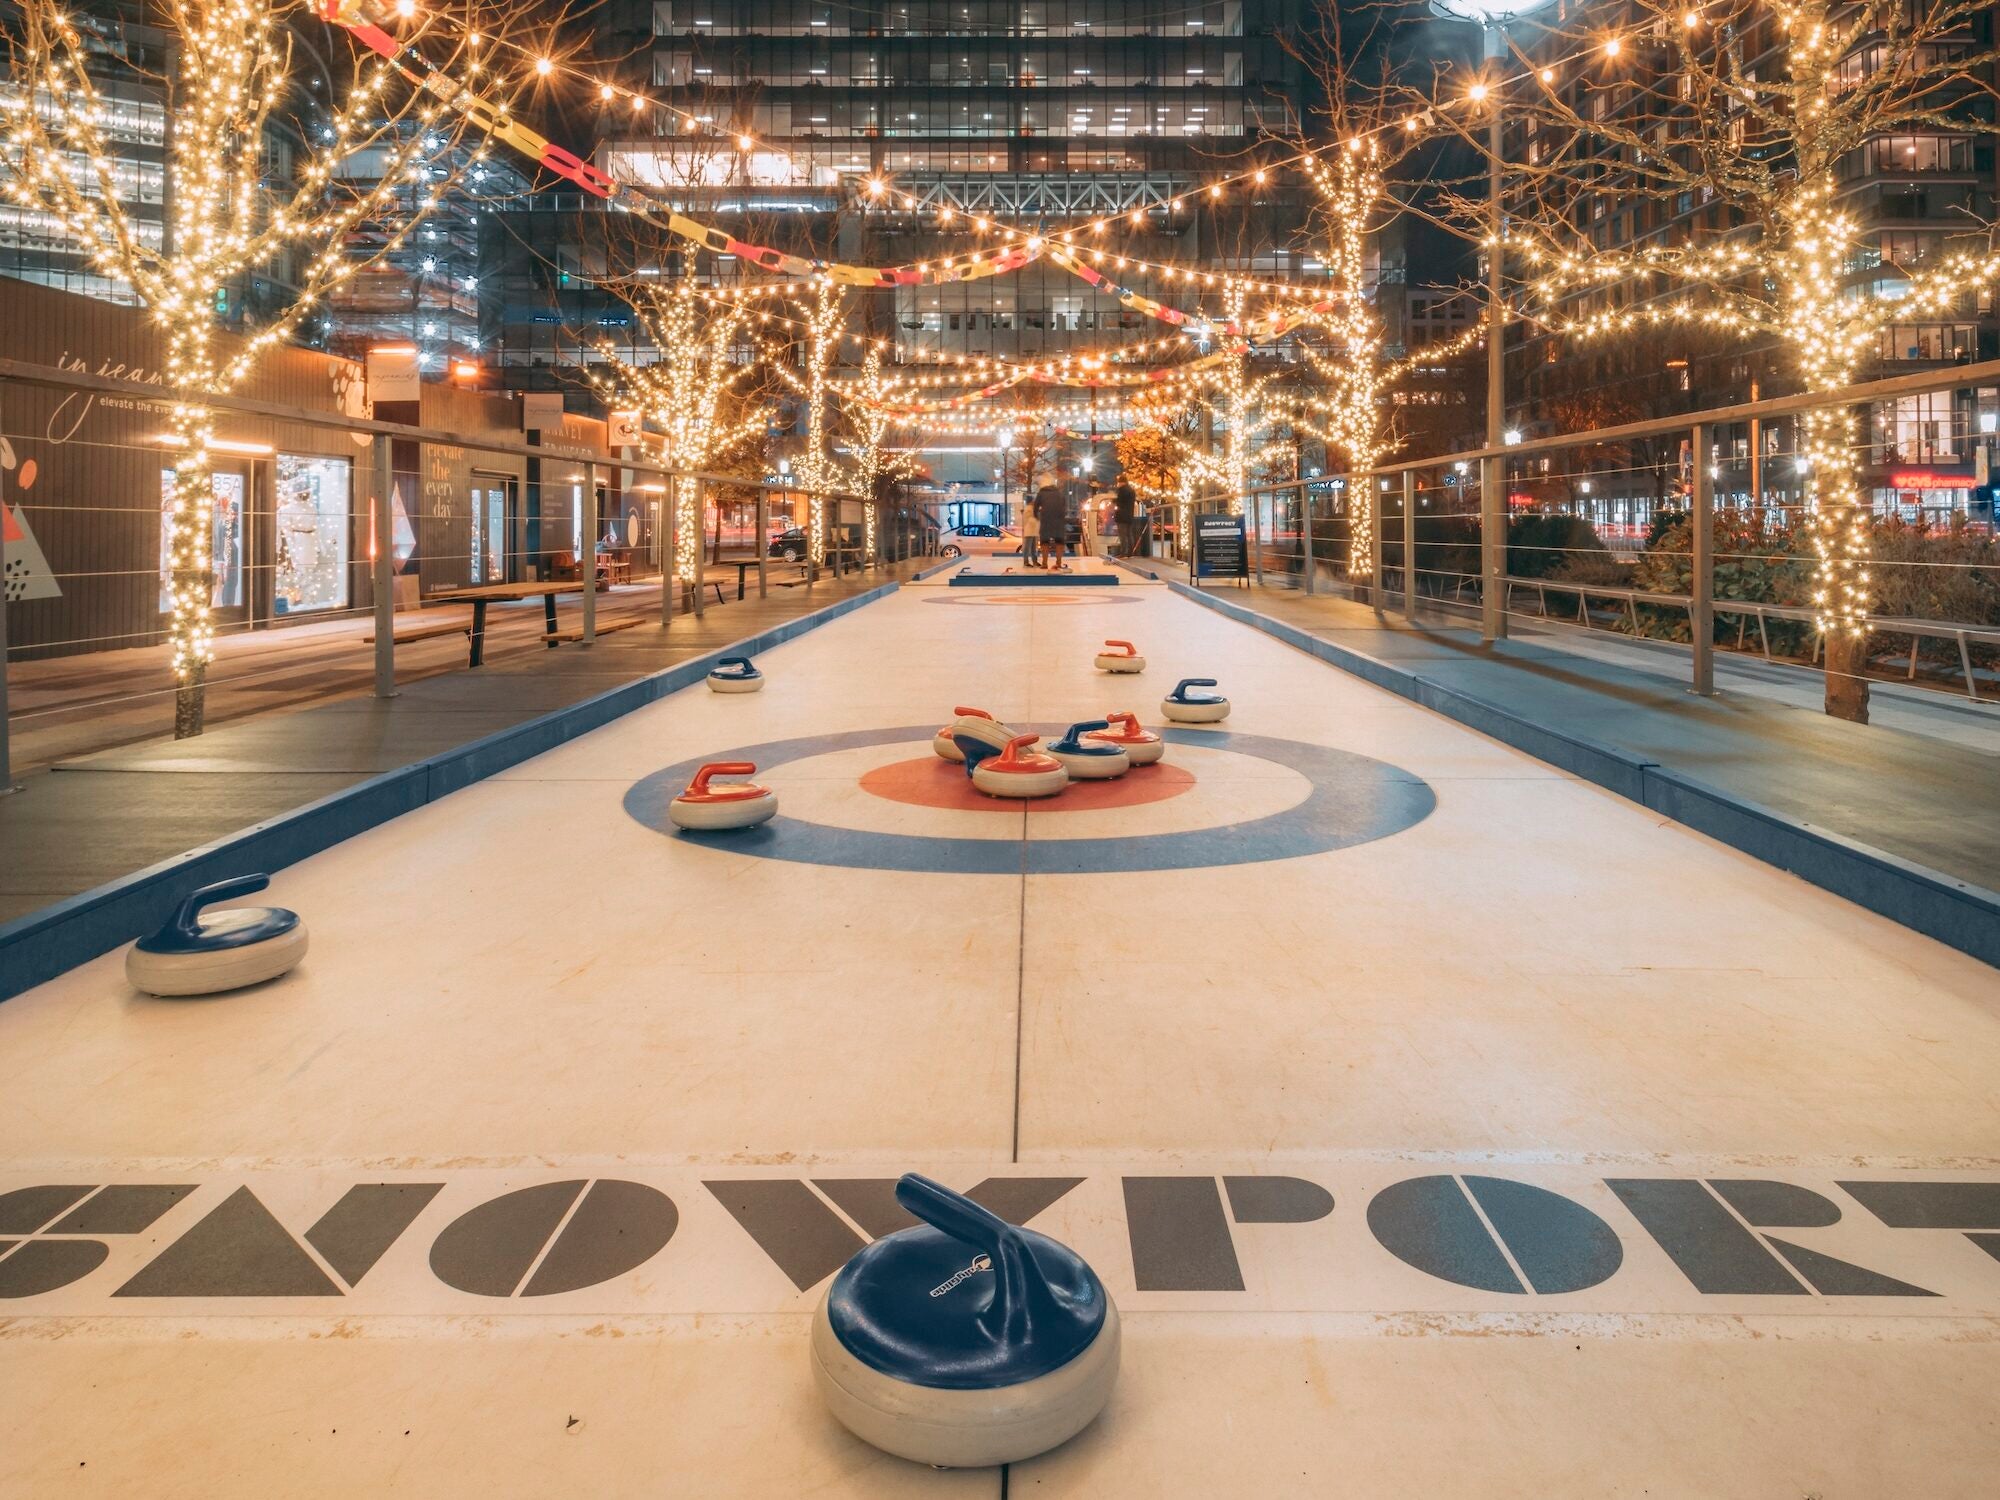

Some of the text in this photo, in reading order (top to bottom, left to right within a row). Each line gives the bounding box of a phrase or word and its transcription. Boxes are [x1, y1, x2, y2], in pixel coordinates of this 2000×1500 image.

[100, 396, 134, 410] elevate
[137, 401, 151, 412] the
[432, 458, 450, 480] the
[426, 481, 453, 502] every
[1907, 476, 1977, 489] CVS pharmacy
[433, 496, 452, 525] day
